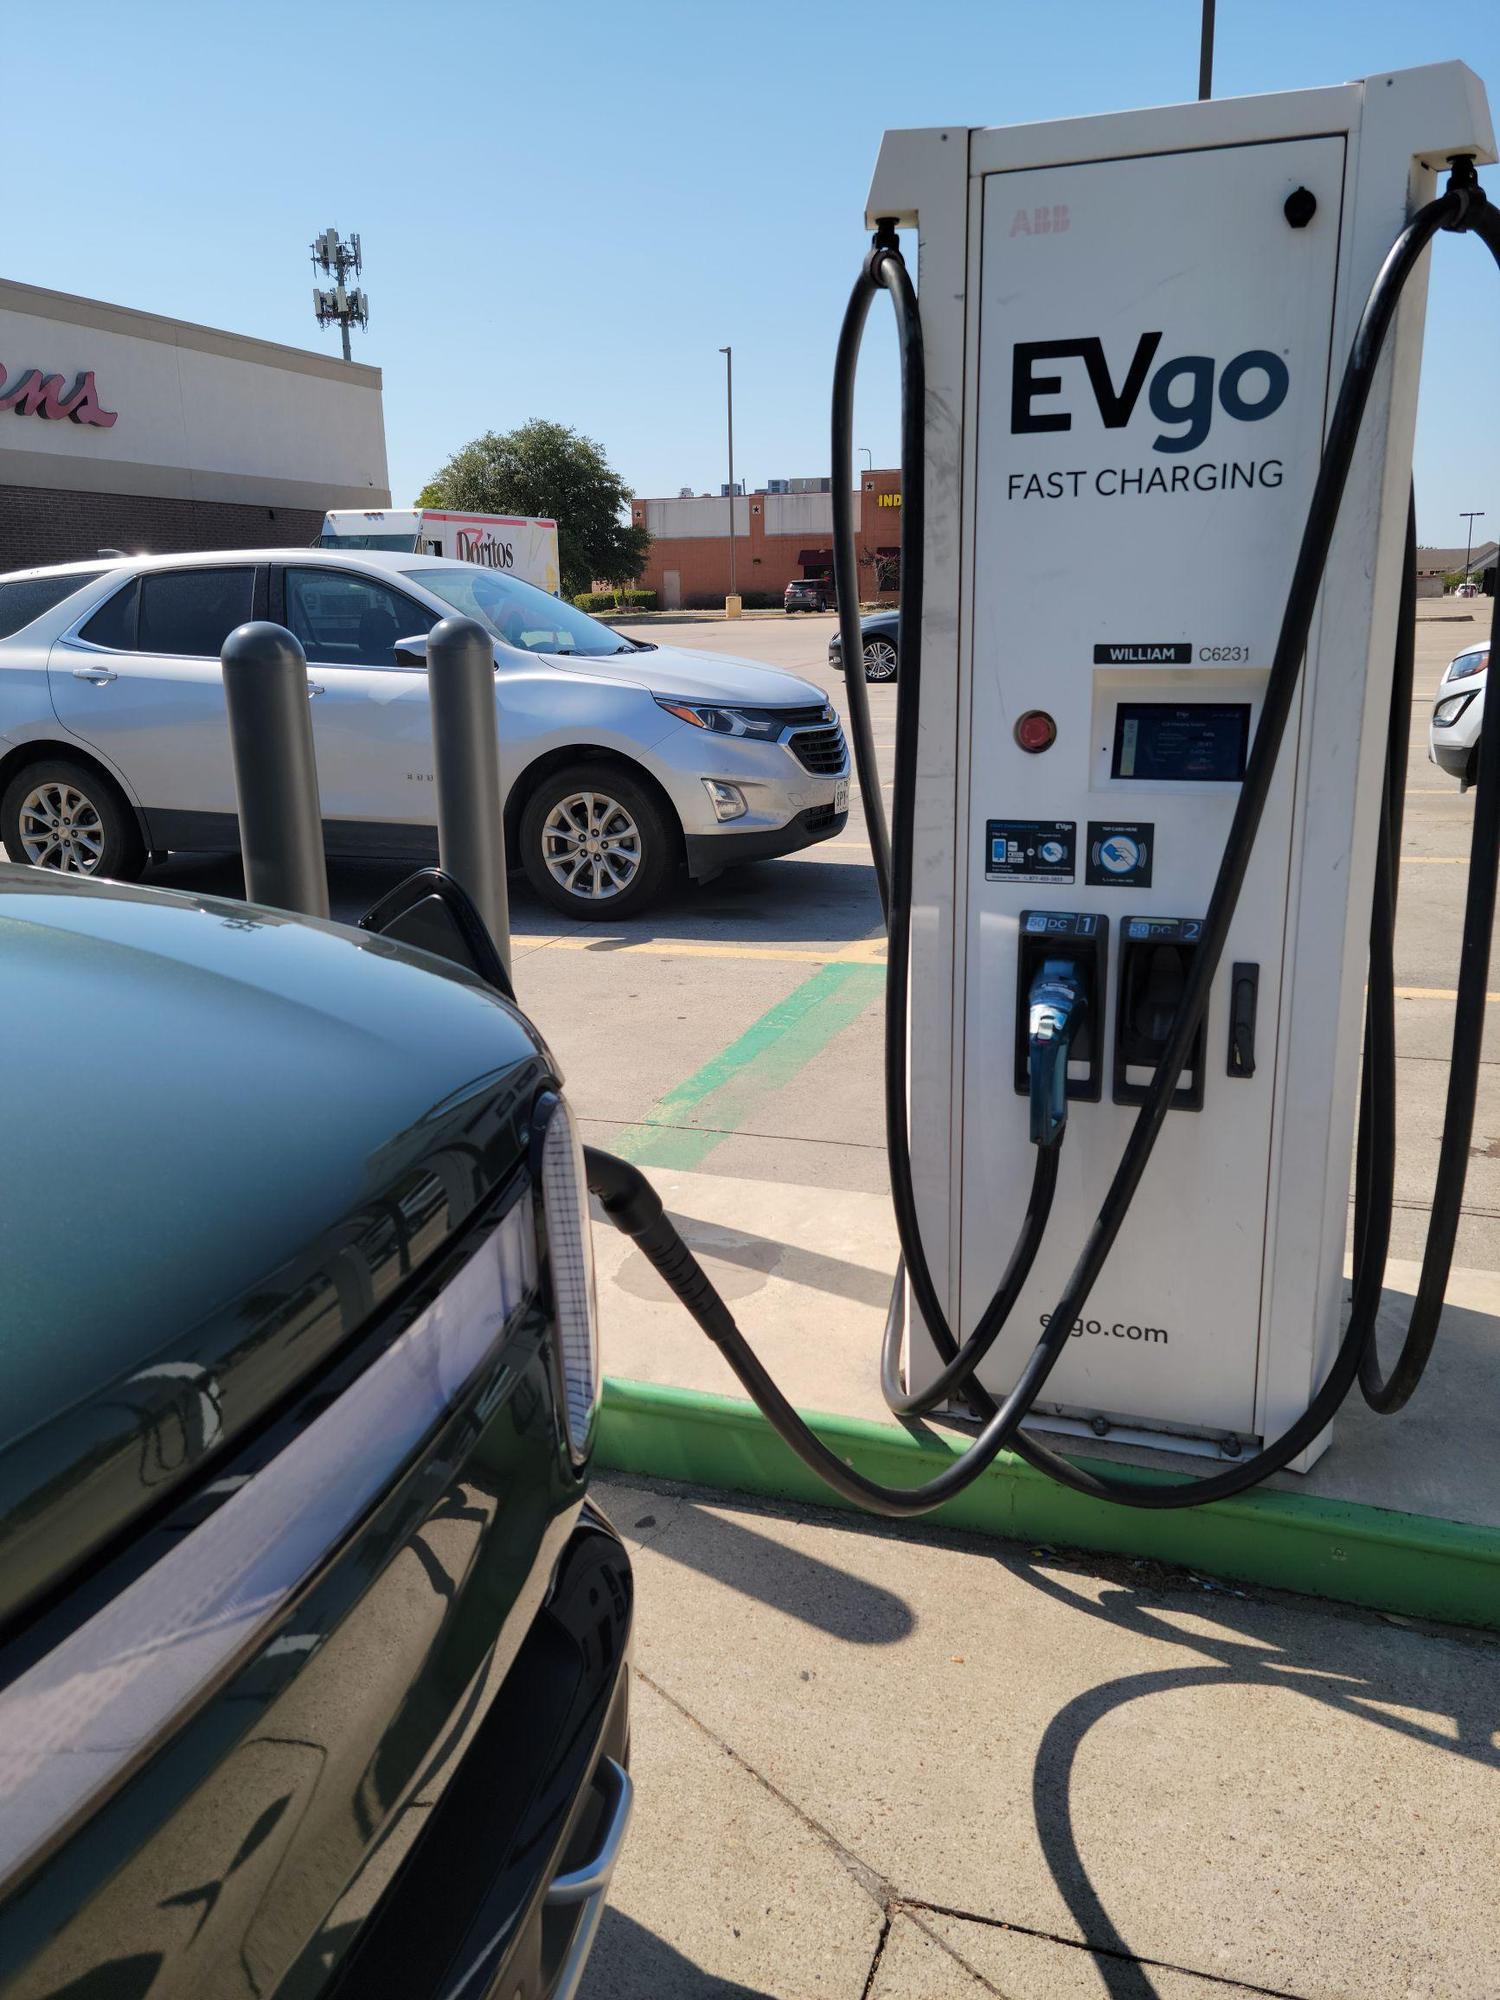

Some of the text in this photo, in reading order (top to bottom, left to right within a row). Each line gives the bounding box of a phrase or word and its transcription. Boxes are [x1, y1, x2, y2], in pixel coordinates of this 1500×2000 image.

[1009, 204, 1070, 237] ABB
[1011, 331, 1290, 454] EVgo
[1008, 459, 1284, 500] FAST CHARGING
[456, 531, 514, 569] Doritos
[1109, 646, 1250, 662] WILLIAM C6231
[1047, 919, 1067, 929] DC
[1081, 917, 1091, 933] 1
[1150, 925, 1170, 935] DC
[1184, 923, 1200, 938] 2
[1039, 1313, 1168, 1344] ego.com
